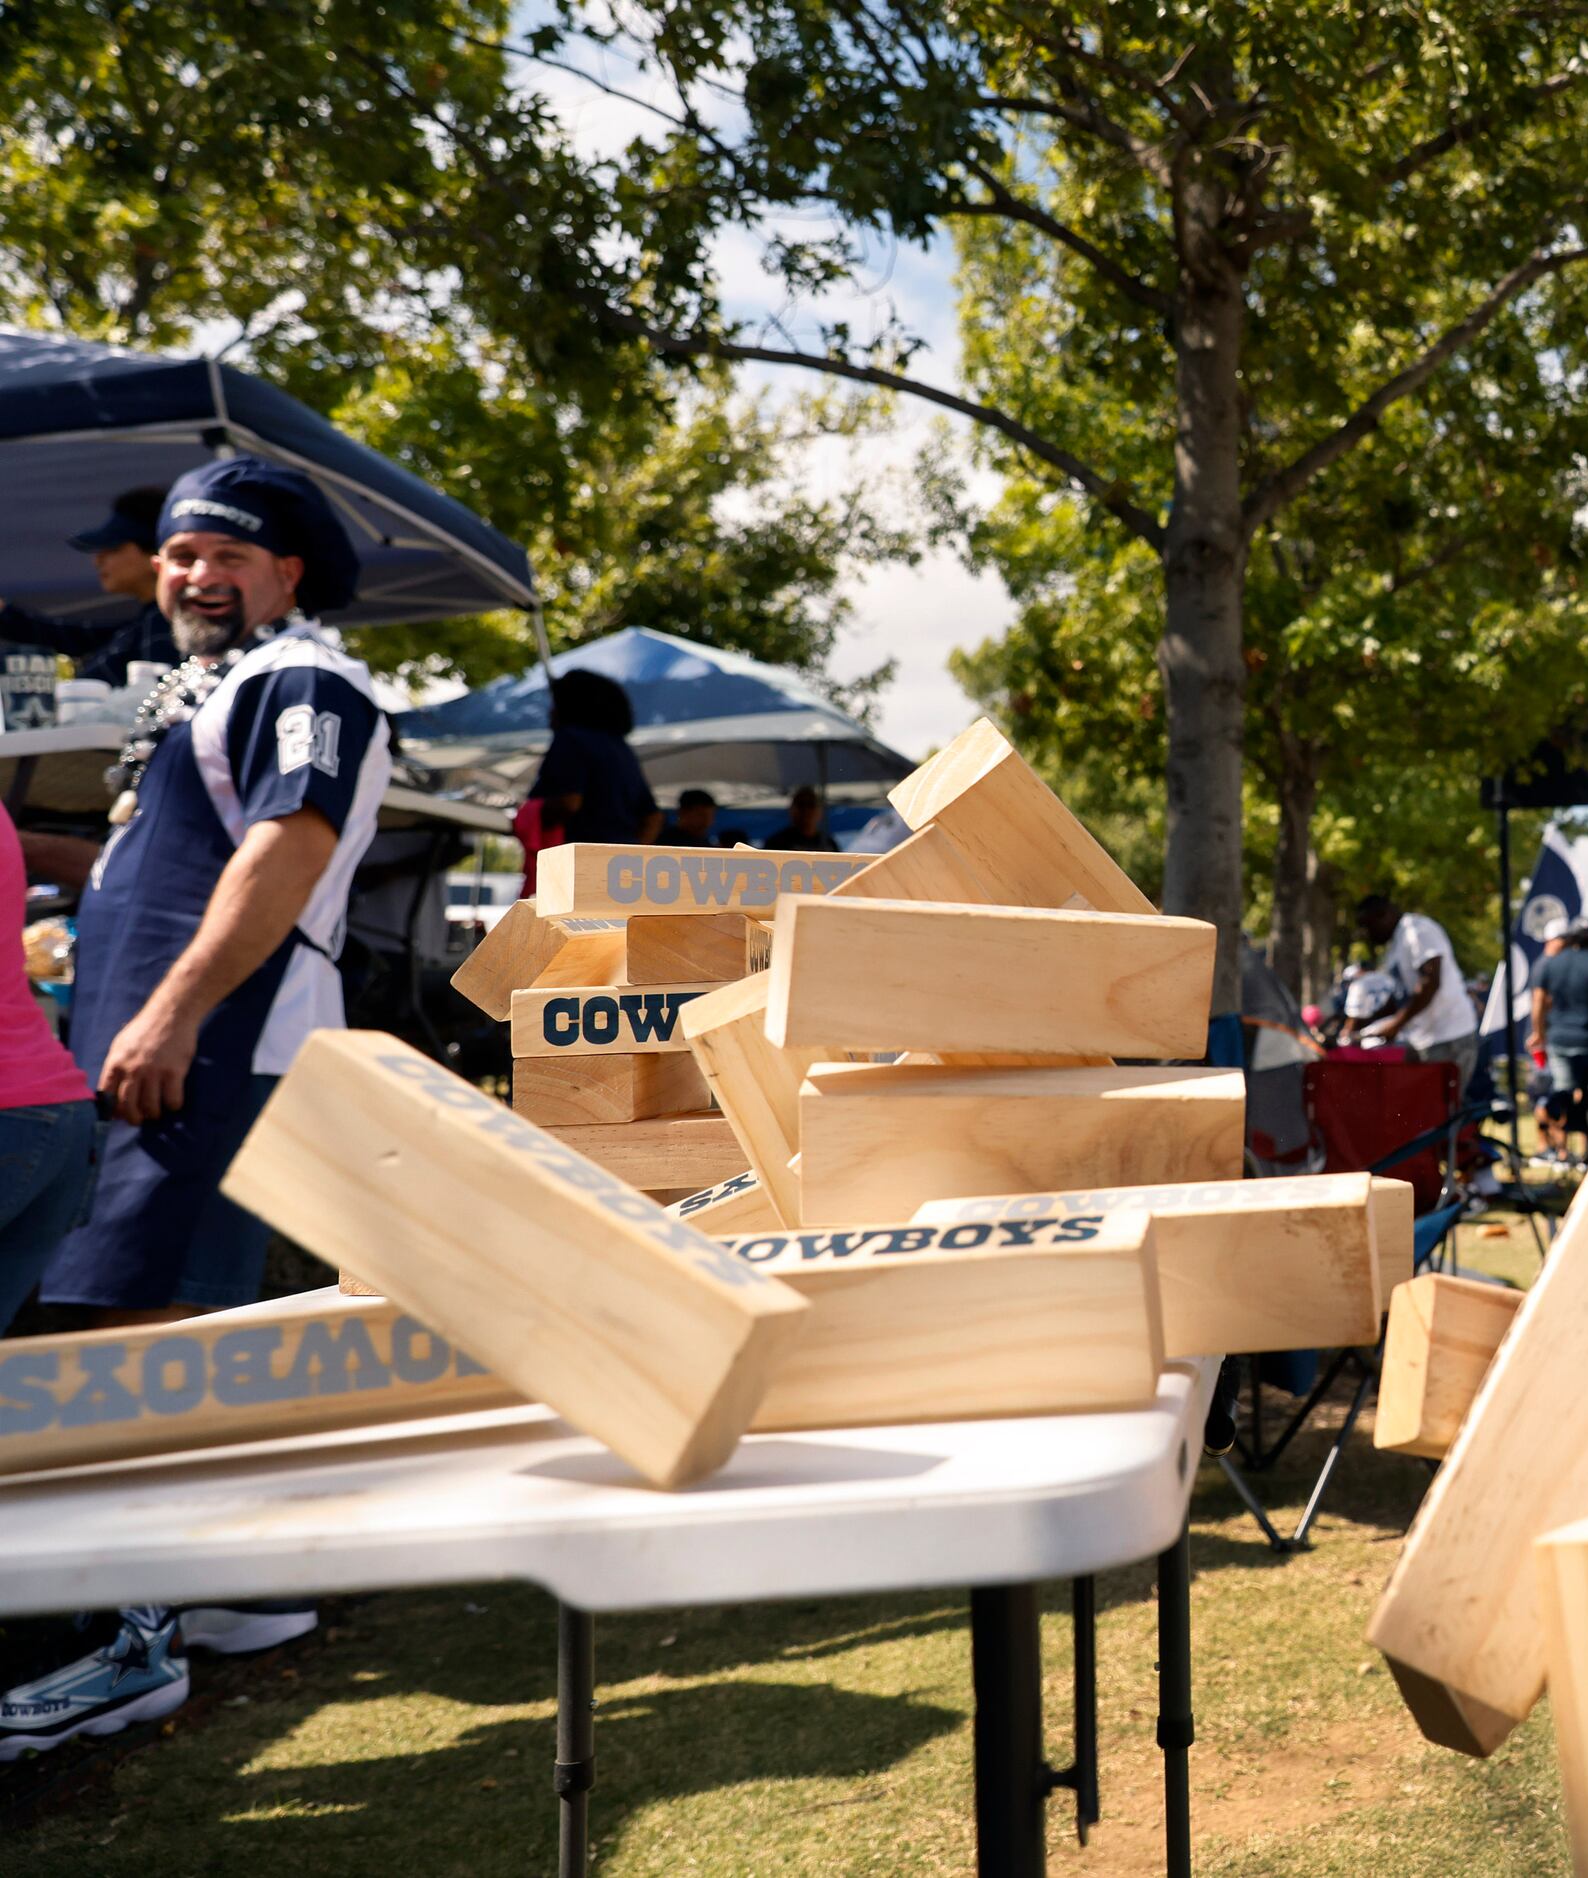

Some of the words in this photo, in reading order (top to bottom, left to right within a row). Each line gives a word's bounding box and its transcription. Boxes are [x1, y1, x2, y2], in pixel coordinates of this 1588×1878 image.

[275, 704, 342, 778] 21
[607, 854, 873, 906] COWBOY
[543, 992, 710, 1047] COW
[720, 1215, 1105, 1263] OWBOYS
